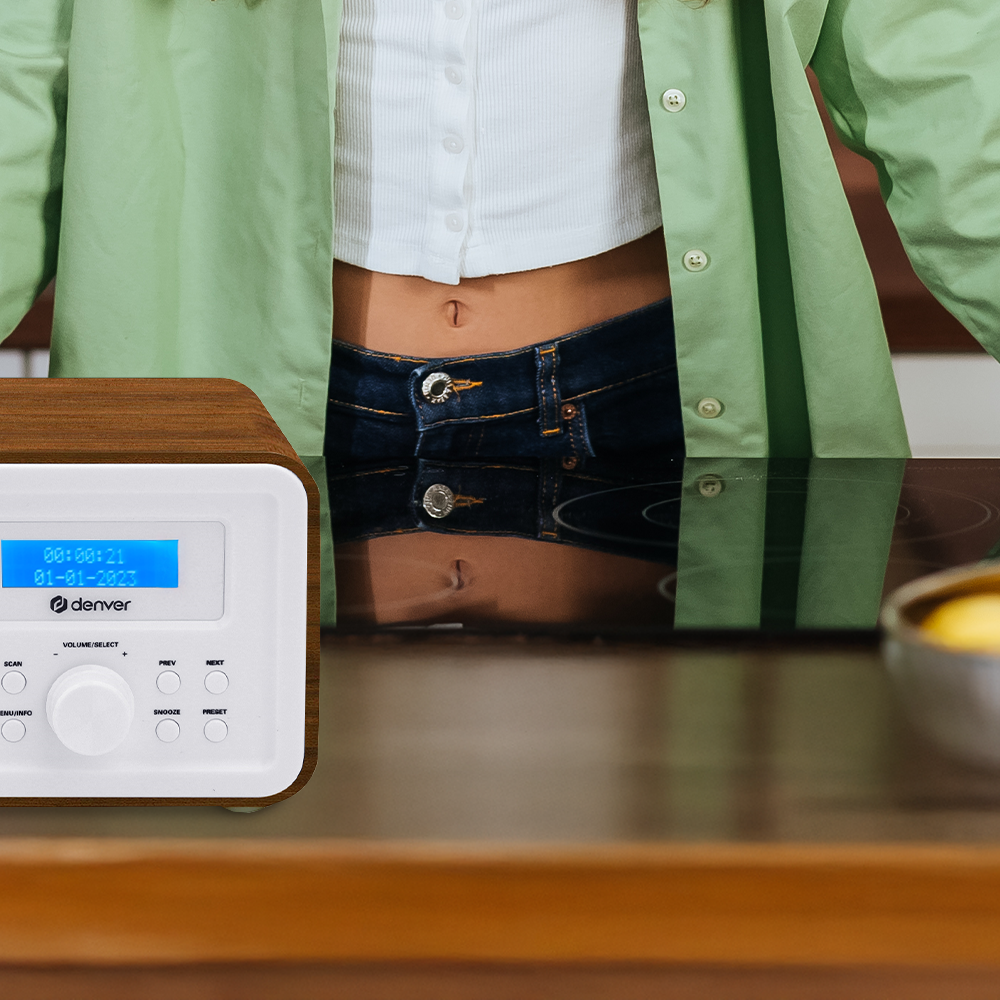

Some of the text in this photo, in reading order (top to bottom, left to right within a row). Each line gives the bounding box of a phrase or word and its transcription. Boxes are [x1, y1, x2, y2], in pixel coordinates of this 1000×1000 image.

[43, 547, 124, 564] 00:00:21
[34, 569, 137, 587] 01-01-2023
[71, 597, 131, 611] denver
[62, 641, 120, 649] VOLUME/SELECT
[3, 660, 23, 668] SCAN
[158, 659, 177, 667] PREV
[205, 659, 225, 667] NEXT
[153, 708, 181, 716] SNOOZE
[202, 708, 228, 716] PRESET
